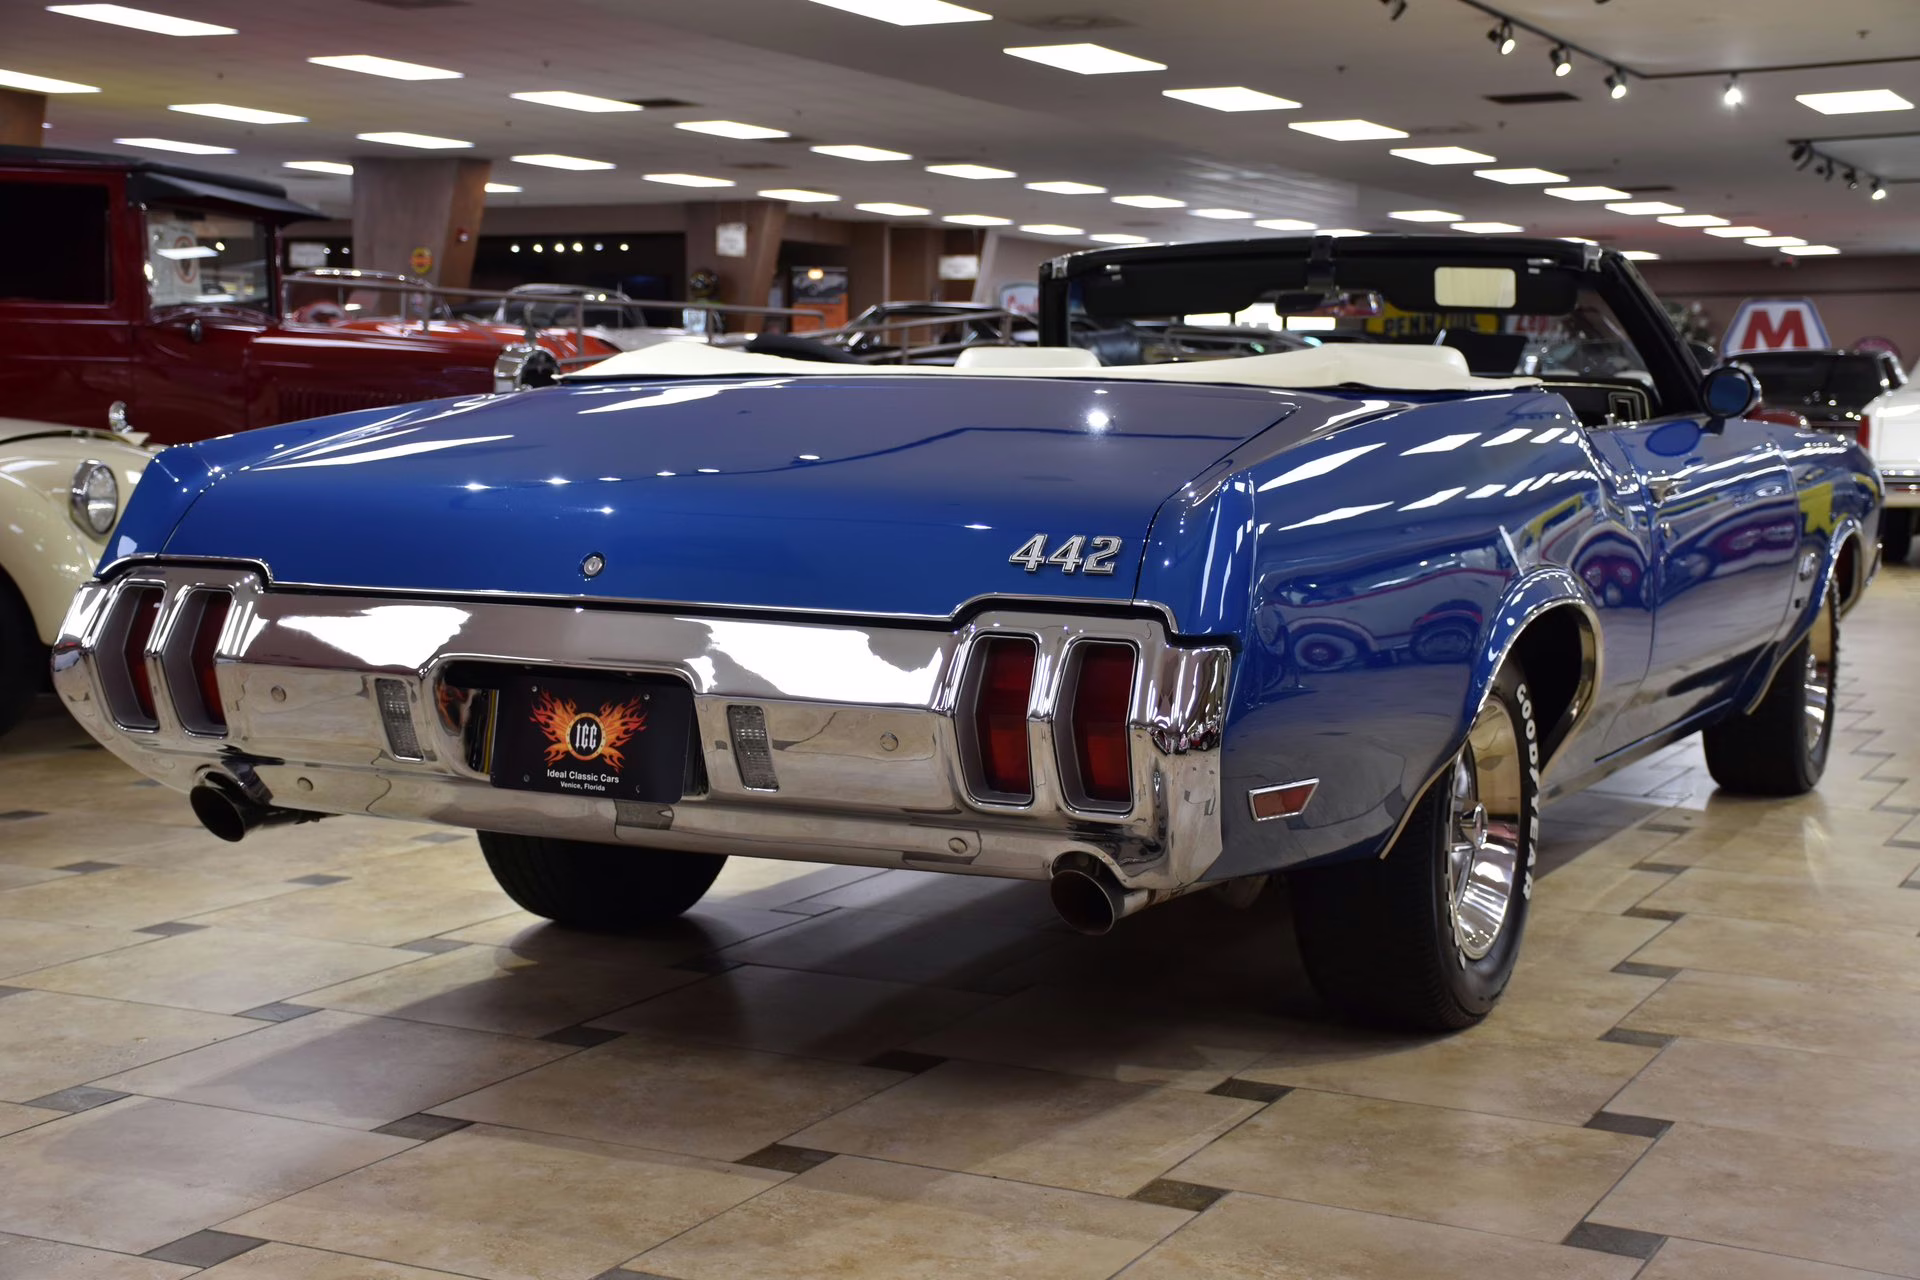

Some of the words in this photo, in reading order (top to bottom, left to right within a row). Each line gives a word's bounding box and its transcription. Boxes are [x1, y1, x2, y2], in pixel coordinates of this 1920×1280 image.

[1740, 310, 1809, 350] M
[1009, 533, 1122, 575] 442
[575, 722, 598, 750] ICC
[547, 769, 567, 779] Ideal
[568, 771, 599, 782] Classic
[600, 774, 620, 784] Cars
[560, 781, 583, 790] Venice,
[584, 783, 606, 792] Florida
[1516, 683, 1540, 900] GOODYEAR
